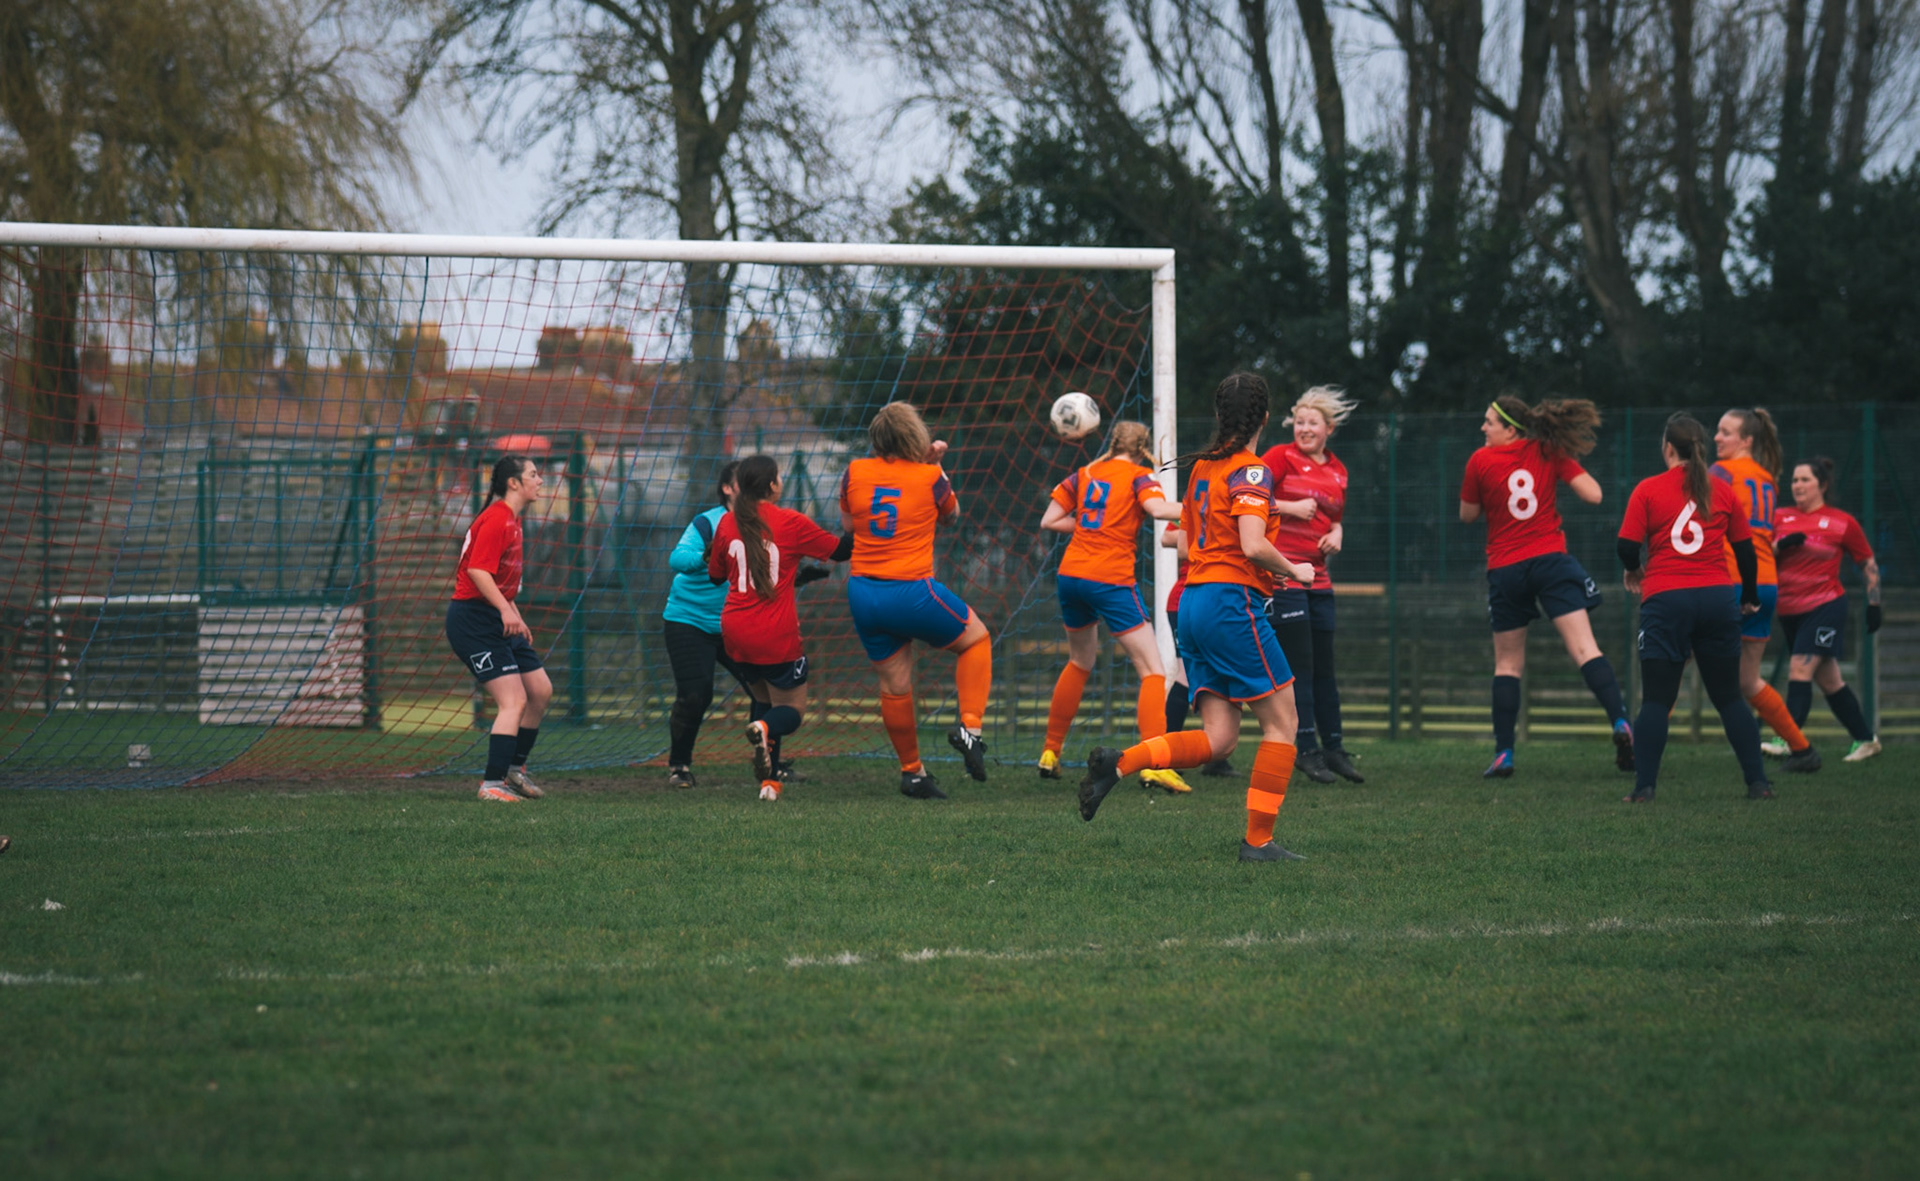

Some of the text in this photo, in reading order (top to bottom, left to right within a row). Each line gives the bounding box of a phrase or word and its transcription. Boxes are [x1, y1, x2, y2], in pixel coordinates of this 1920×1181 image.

[870, 487, 901, 538] 5
[1081, 480, 1111, 529] 9
[1508, 469, 1538, 520] 8
[1745, 479, 1776, 530] 10
[1671, 499, 1704, 555] 6
